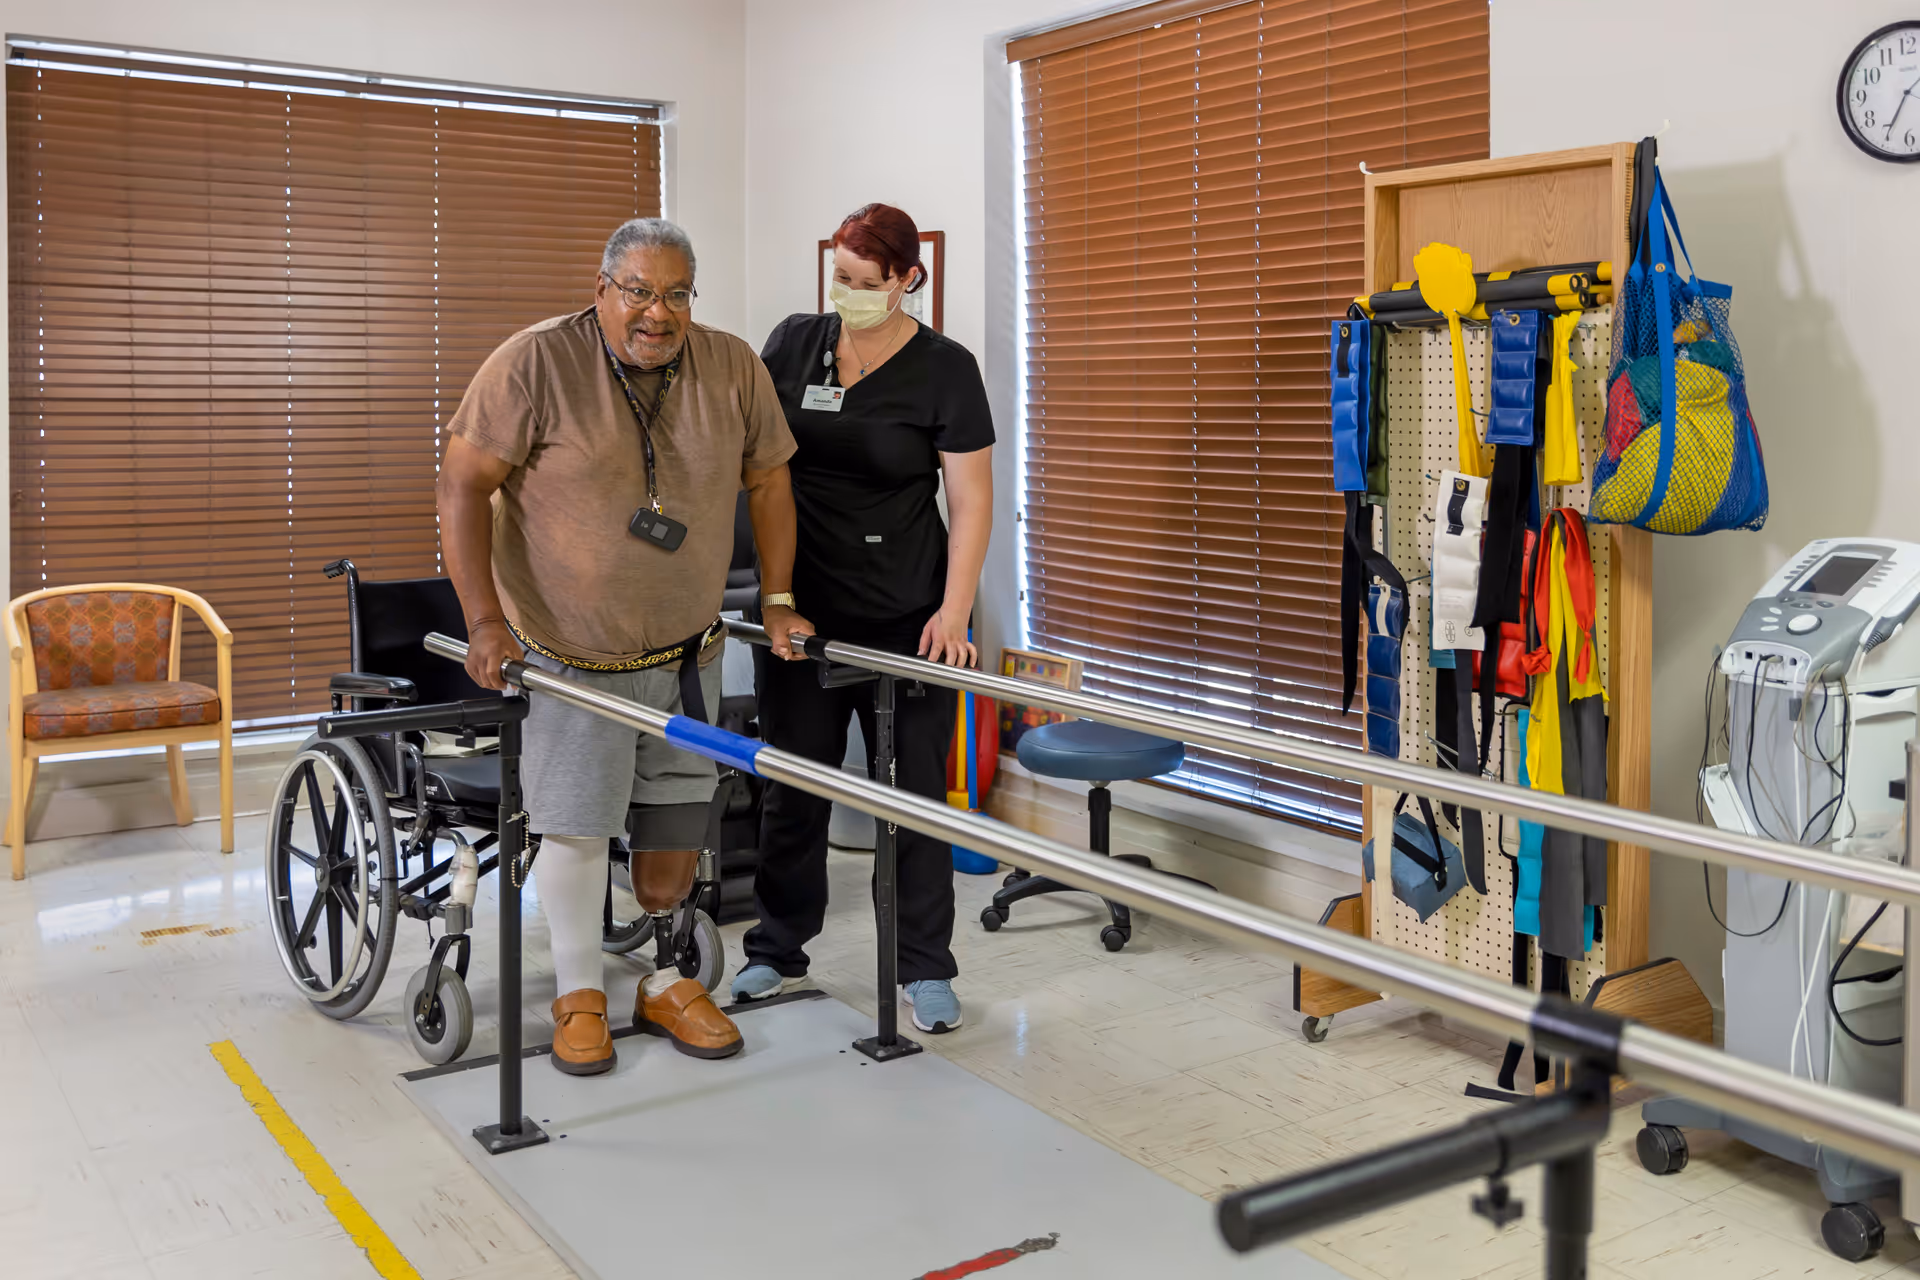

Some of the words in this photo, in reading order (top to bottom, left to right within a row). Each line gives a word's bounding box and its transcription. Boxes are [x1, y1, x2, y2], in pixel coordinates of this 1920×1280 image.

[1900, 36, 1916, 55] 12
[1880, 48, 1893, 66] 11
[1864, 67, 1881, 86] 10
[1856, 89, 1867, 107] 9
[1865, 110, 1875, 128] 8
[1882, 123, 1893, 141] 7
[1904, 128, 1915, 147] 6
